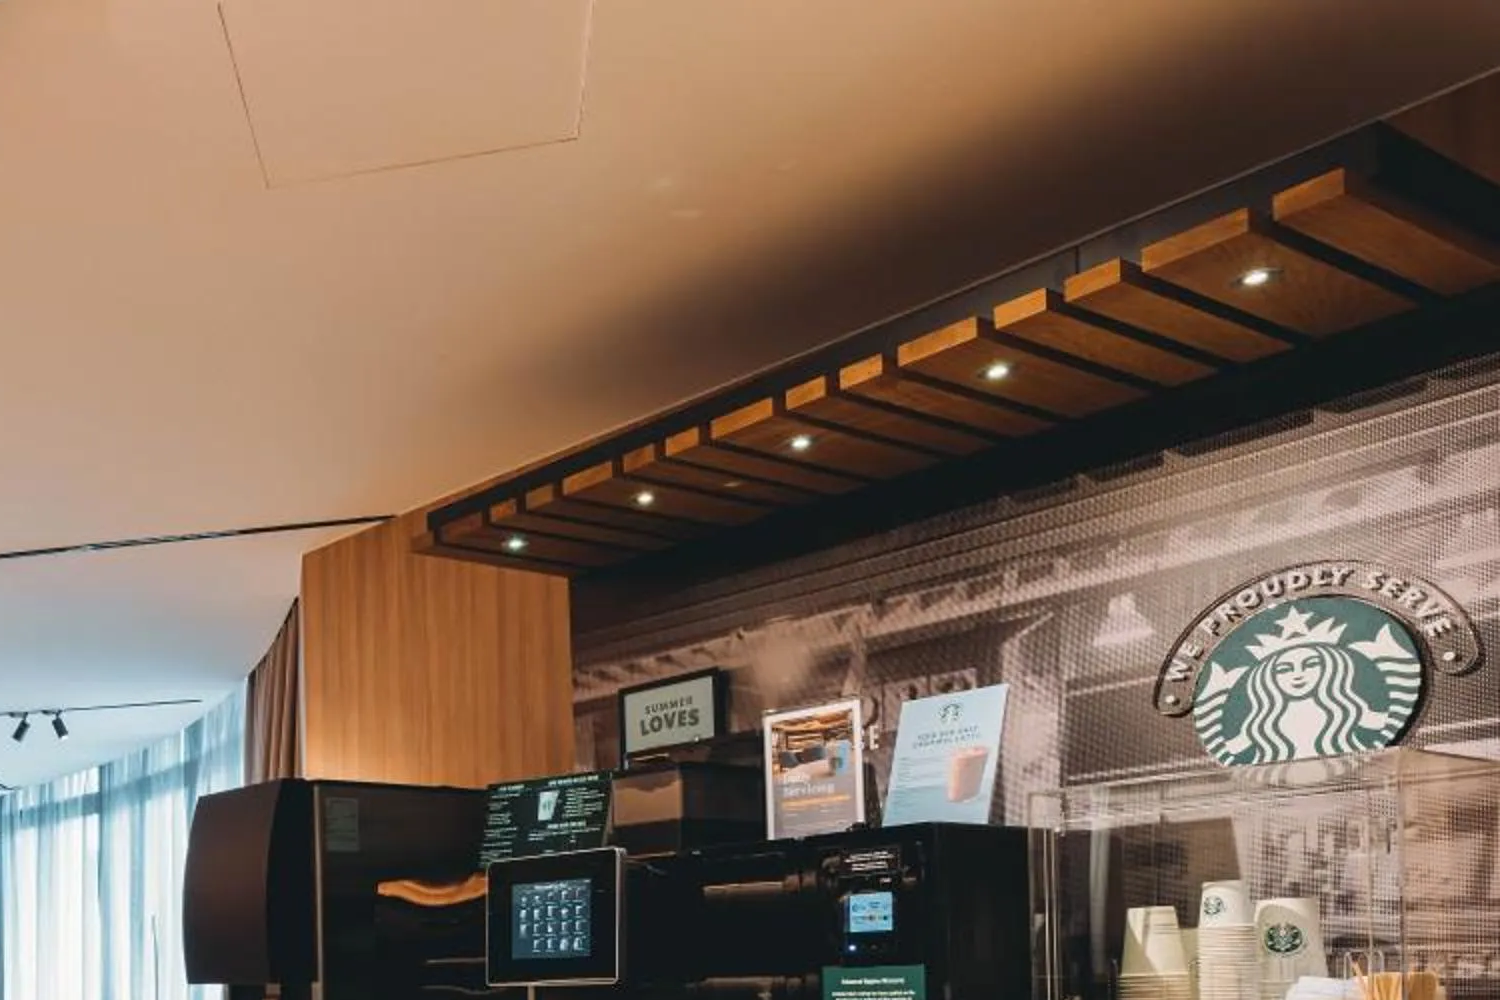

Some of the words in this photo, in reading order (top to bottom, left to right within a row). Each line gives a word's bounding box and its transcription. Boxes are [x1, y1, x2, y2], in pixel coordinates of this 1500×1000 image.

[1168, 640, 1201, 683] WE
[1200, 568, 1354, 637] PROUDLY
[1365, 571, 1457, 638] SERVE
[644, 695, 693, 715] SUMMER
[640, 708, 700, 737] LOVES
